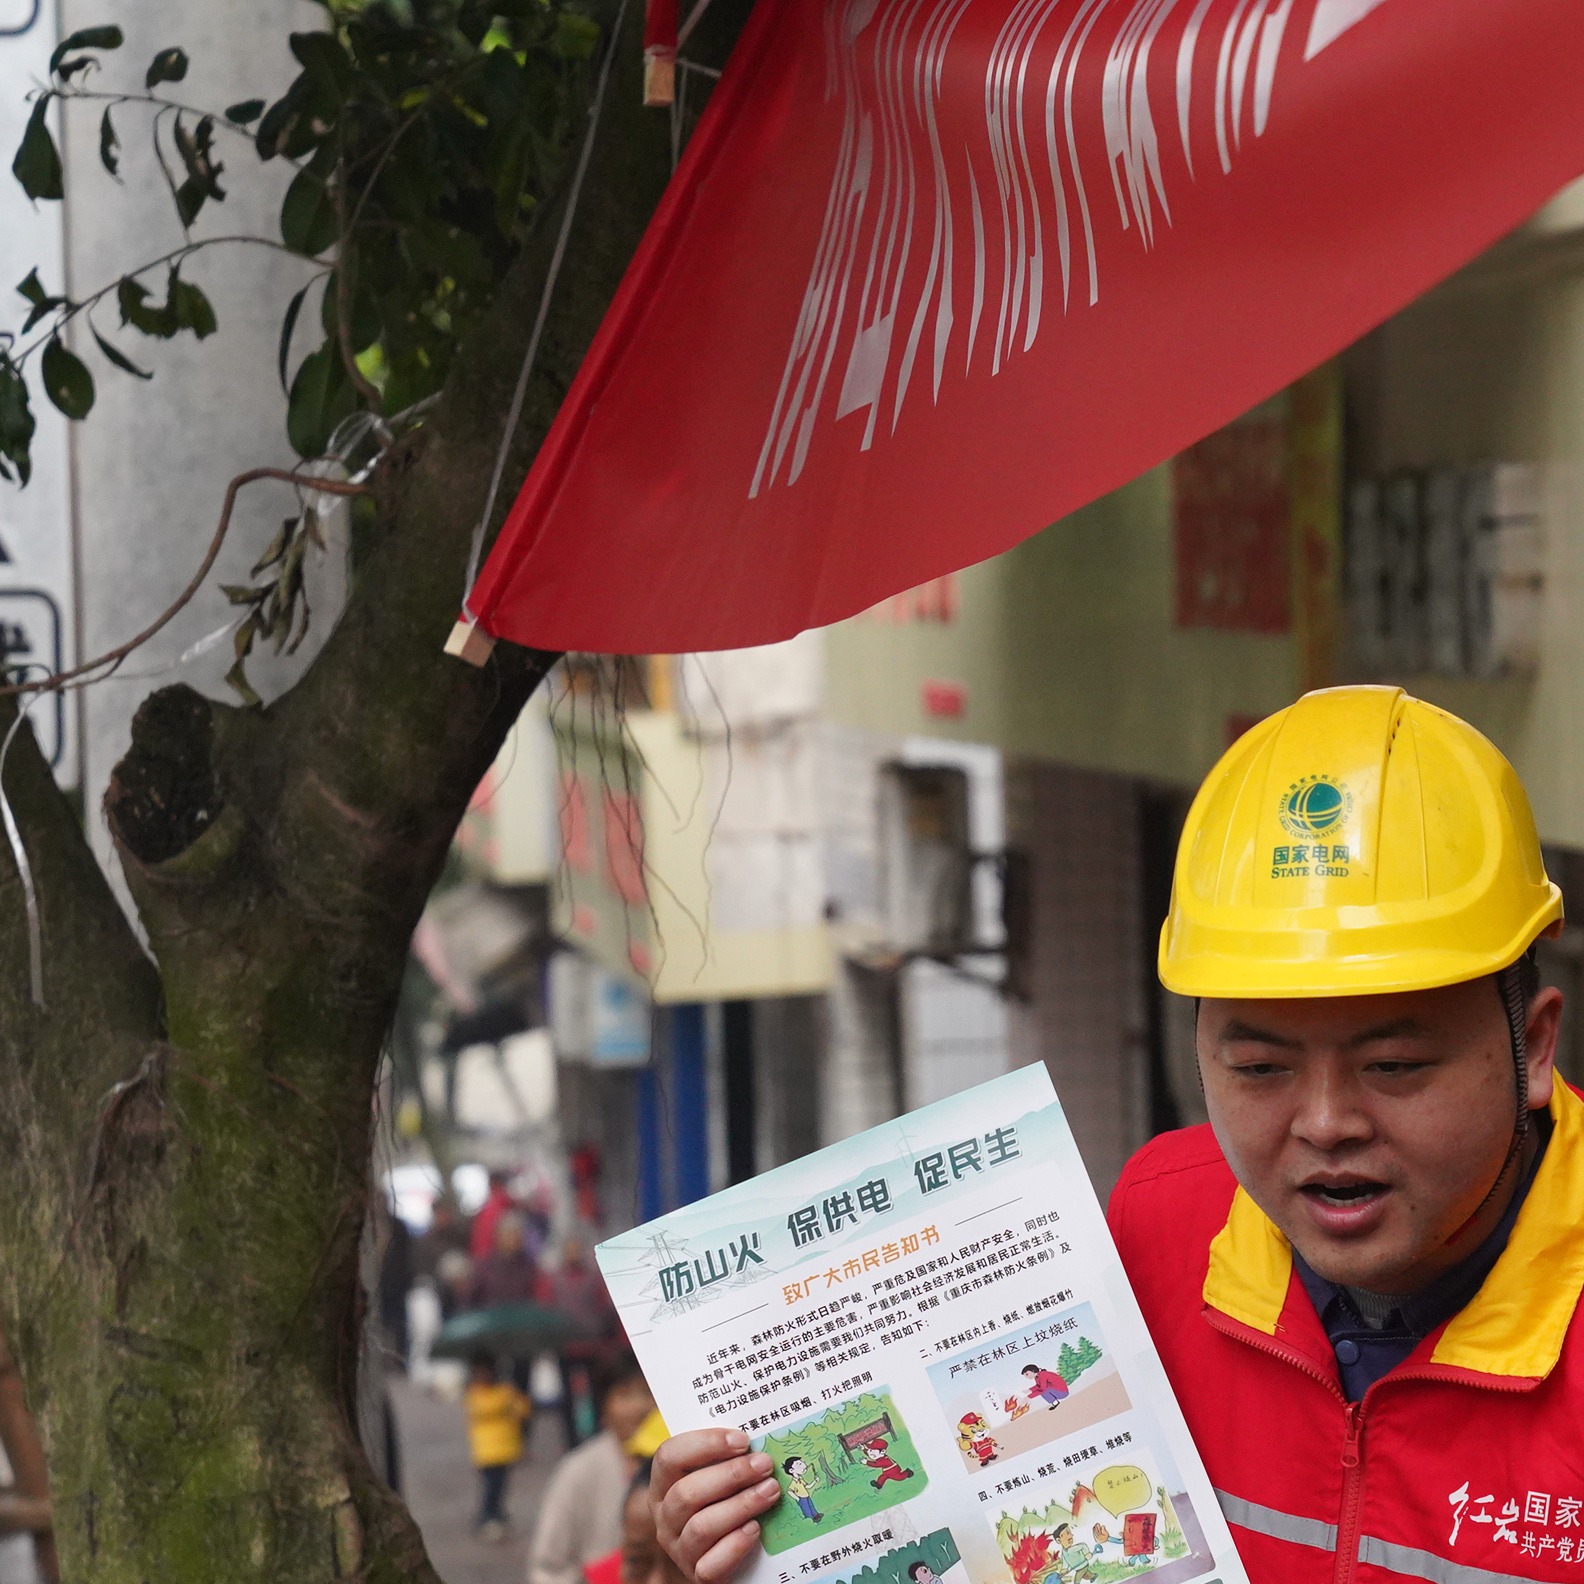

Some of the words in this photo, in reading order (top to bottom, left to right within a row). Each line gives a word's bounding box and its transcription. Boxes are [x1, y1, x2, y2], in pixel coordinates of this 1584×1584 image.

[1271, 867, 1310, 879] STATE
[1315, 864, 1349, 877] GRID
[1273, 844, 1350, 866] 国家电网
[656, 1231, 764, 1304] 防山火
[786, 1178, 894, 1249] 保供电
[912, 1125, 1023, 1197] 促民生
[779, 1223, 943, 1306] 致广大市民告知书
[946, 1315, 1079, 1379] 严禁在林区上坟烧纸
[777, 1527, 894, 1584] 三、不要在野外烧火取暖
